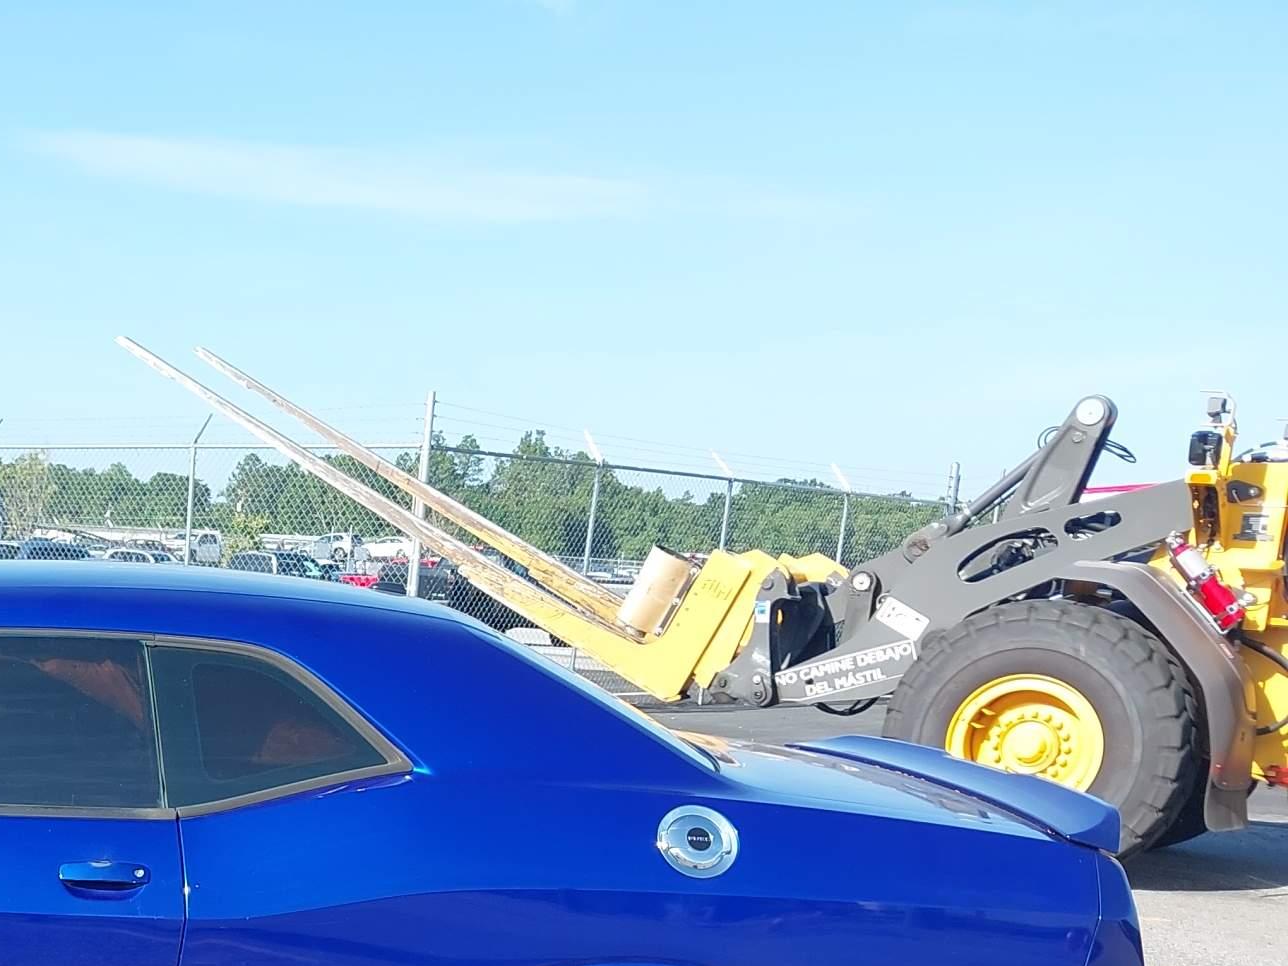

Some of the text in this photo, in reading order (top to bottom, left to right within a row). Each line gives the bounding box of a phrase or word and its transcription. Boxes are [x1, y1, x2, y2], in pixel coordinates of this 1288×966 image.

[775, 643, 912, 686] NO CAMINE DEBAJO
[805, 667, 886, 697] DEL MÁSTIL
